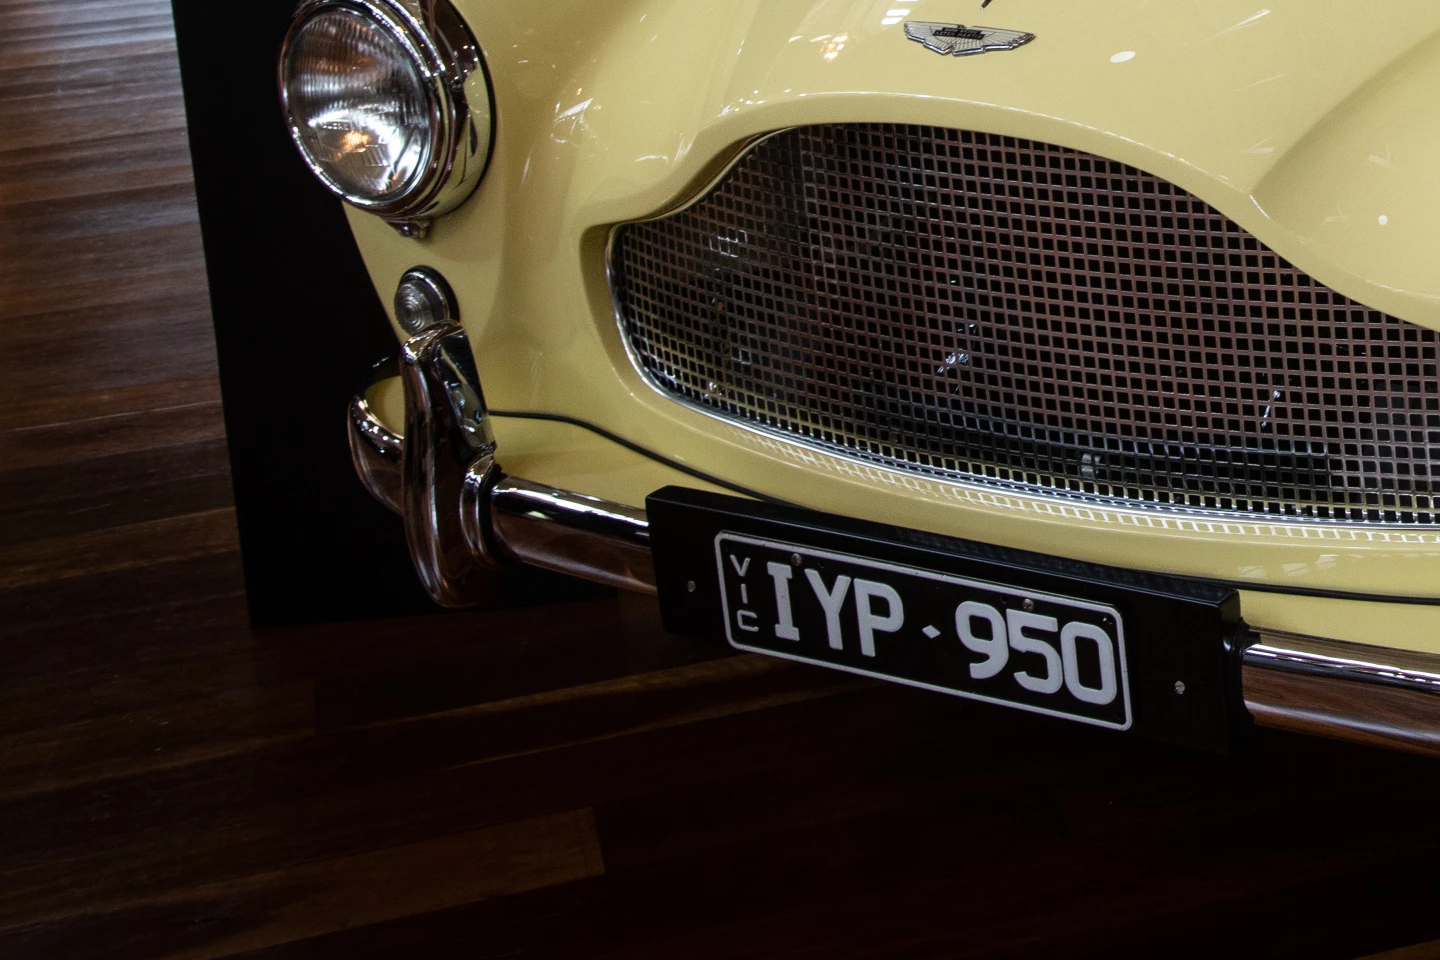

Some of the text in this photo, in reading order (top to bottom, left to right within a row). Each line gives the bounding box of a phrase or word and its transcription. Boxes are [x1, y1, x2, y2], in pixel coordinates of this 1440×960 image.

[729, 554, 760, 632] VIC
[766, 561, 1118, 706] IYP 950
